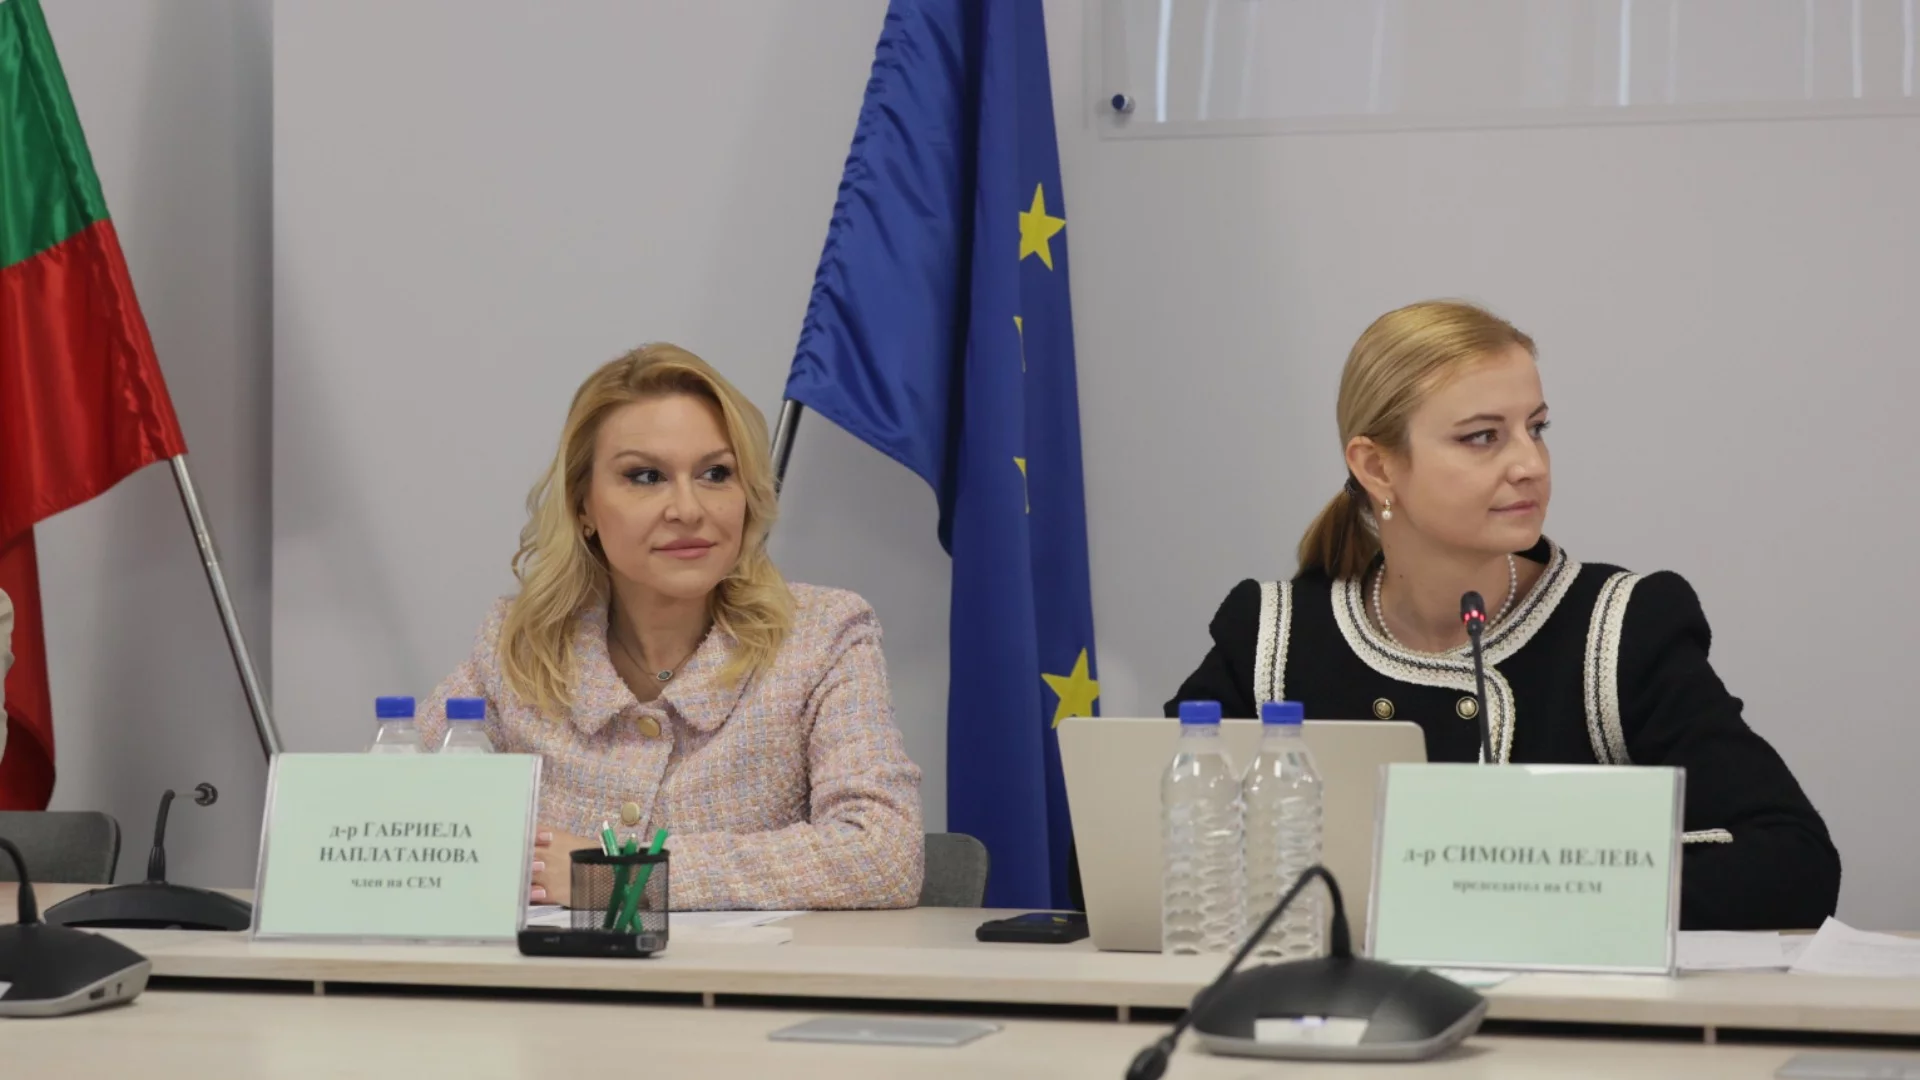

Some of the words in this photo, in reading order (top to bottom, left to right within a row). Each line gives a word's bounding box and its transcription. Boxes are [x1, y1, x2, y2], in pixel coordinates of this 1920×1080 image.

[329, 824, 357, 842] д-р
[363, 821, 473, 839] ГАБРИЕЛА
[319, 846, 479, 864] НАПЛАТАНОВА
[1402, 846, 1435, 867] д-р
[1442, 845, 1551, 866] СИМОНА
[1559, 847, 1655, 869] ВЕЛЕВА
[406, 876, 442, 889] СЕМ
[1565, 880, 1602, 895] СЕМ
